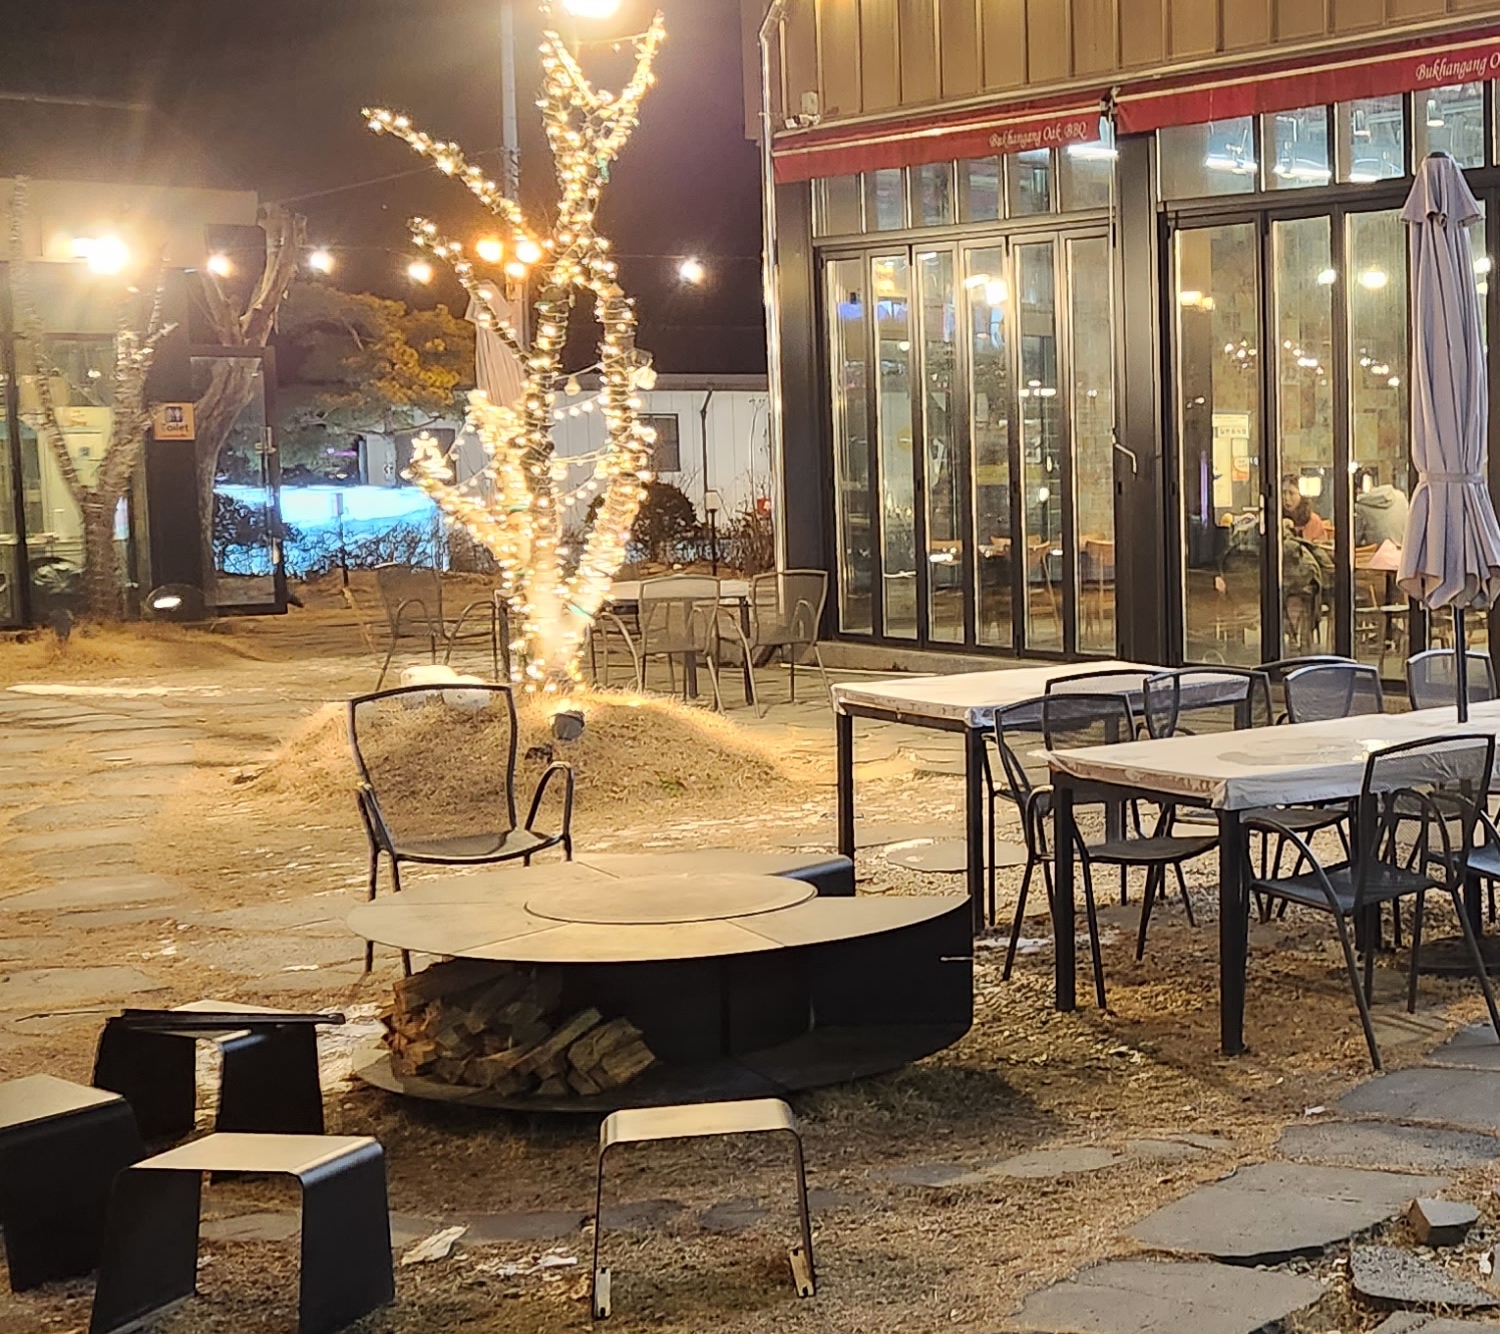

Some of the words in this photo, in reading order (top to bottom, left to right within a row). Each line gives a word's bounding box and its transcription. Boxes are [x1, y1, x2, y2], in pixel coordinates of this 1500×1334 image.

[1415, 56, 1488, 81] Bukhangang
[1042, 123, 1062, 142] Oak
[1063, 121, 1087, 140] BBQ
